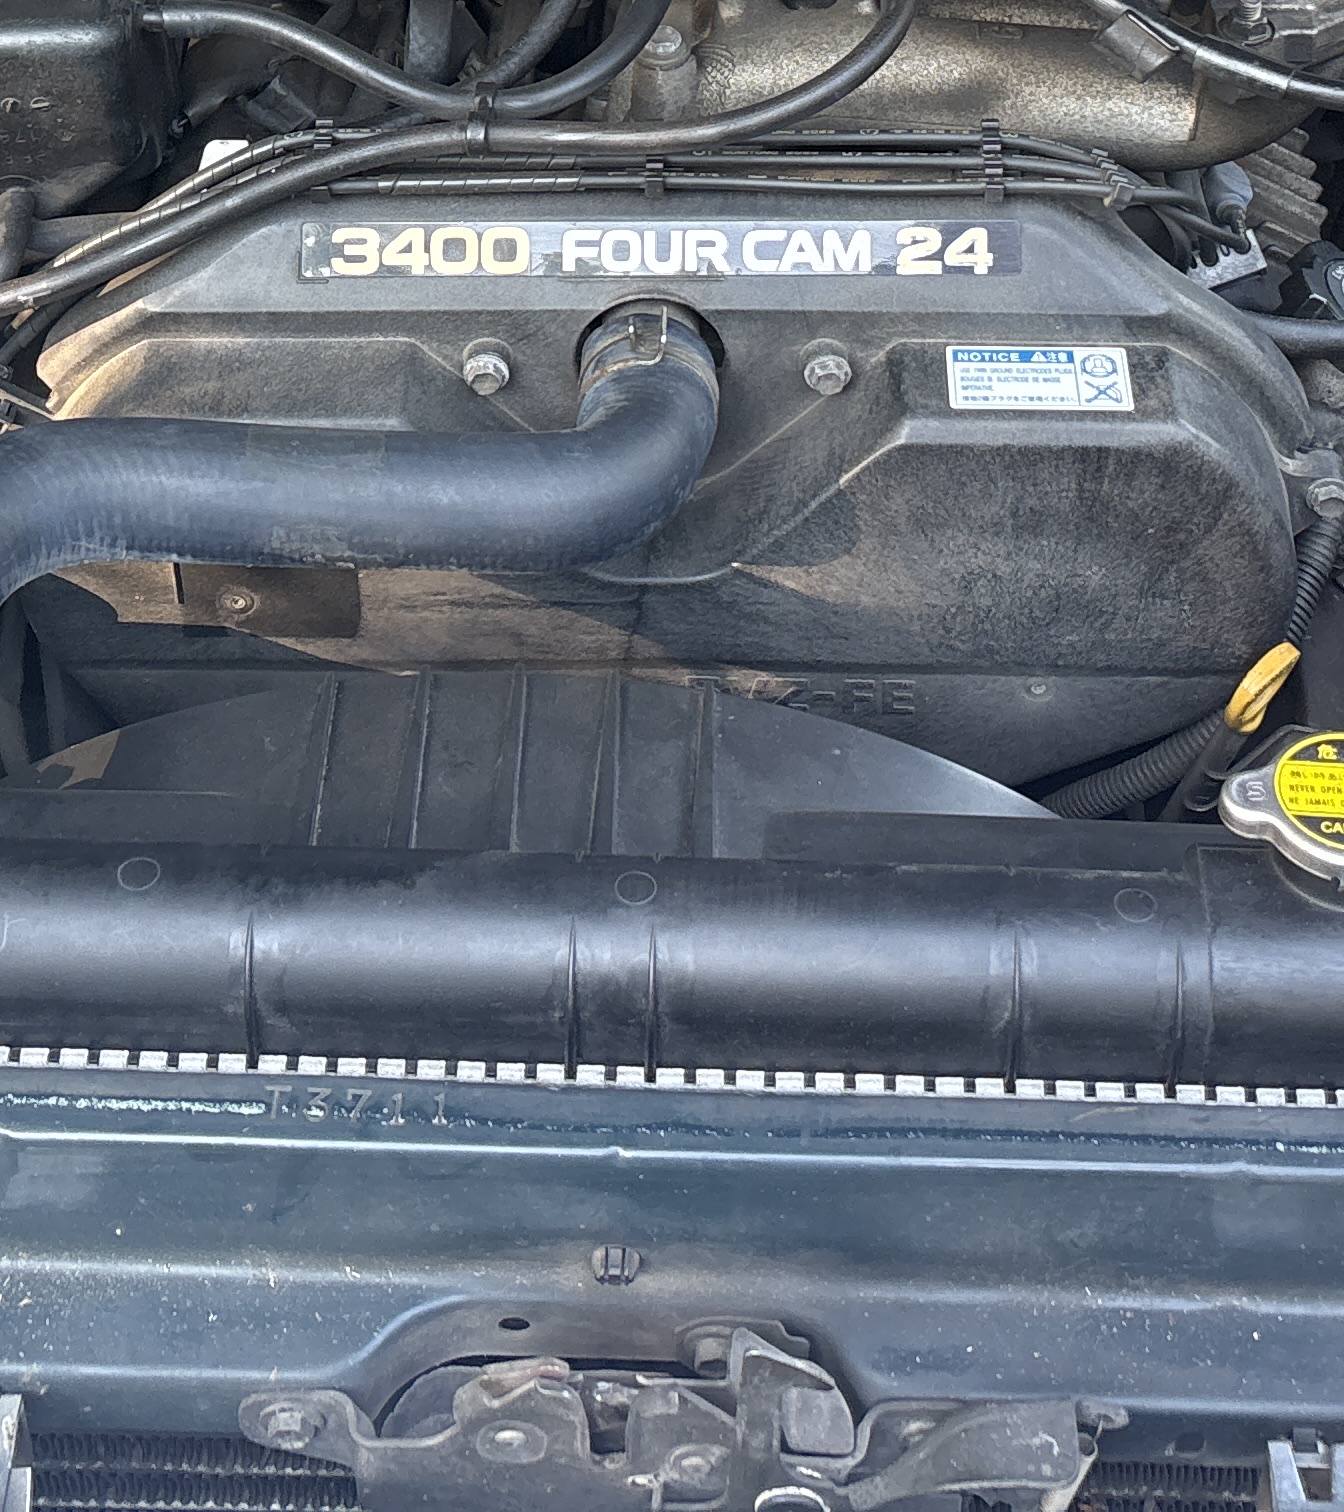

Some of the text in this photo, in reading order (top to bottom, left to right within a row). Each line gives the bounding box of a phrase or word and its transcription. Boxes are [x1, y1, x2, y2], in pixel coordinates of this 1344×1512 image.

[330, 226, 994, 276] 3400 FOUR CAM 24
[957, 351, 1021, 362] NOTICE
[1289, 784, 1316, 794] NEVER
[1320, 786, 1343, 795] OPEN
[1305, 798, 1336, 808] JAMAIS
